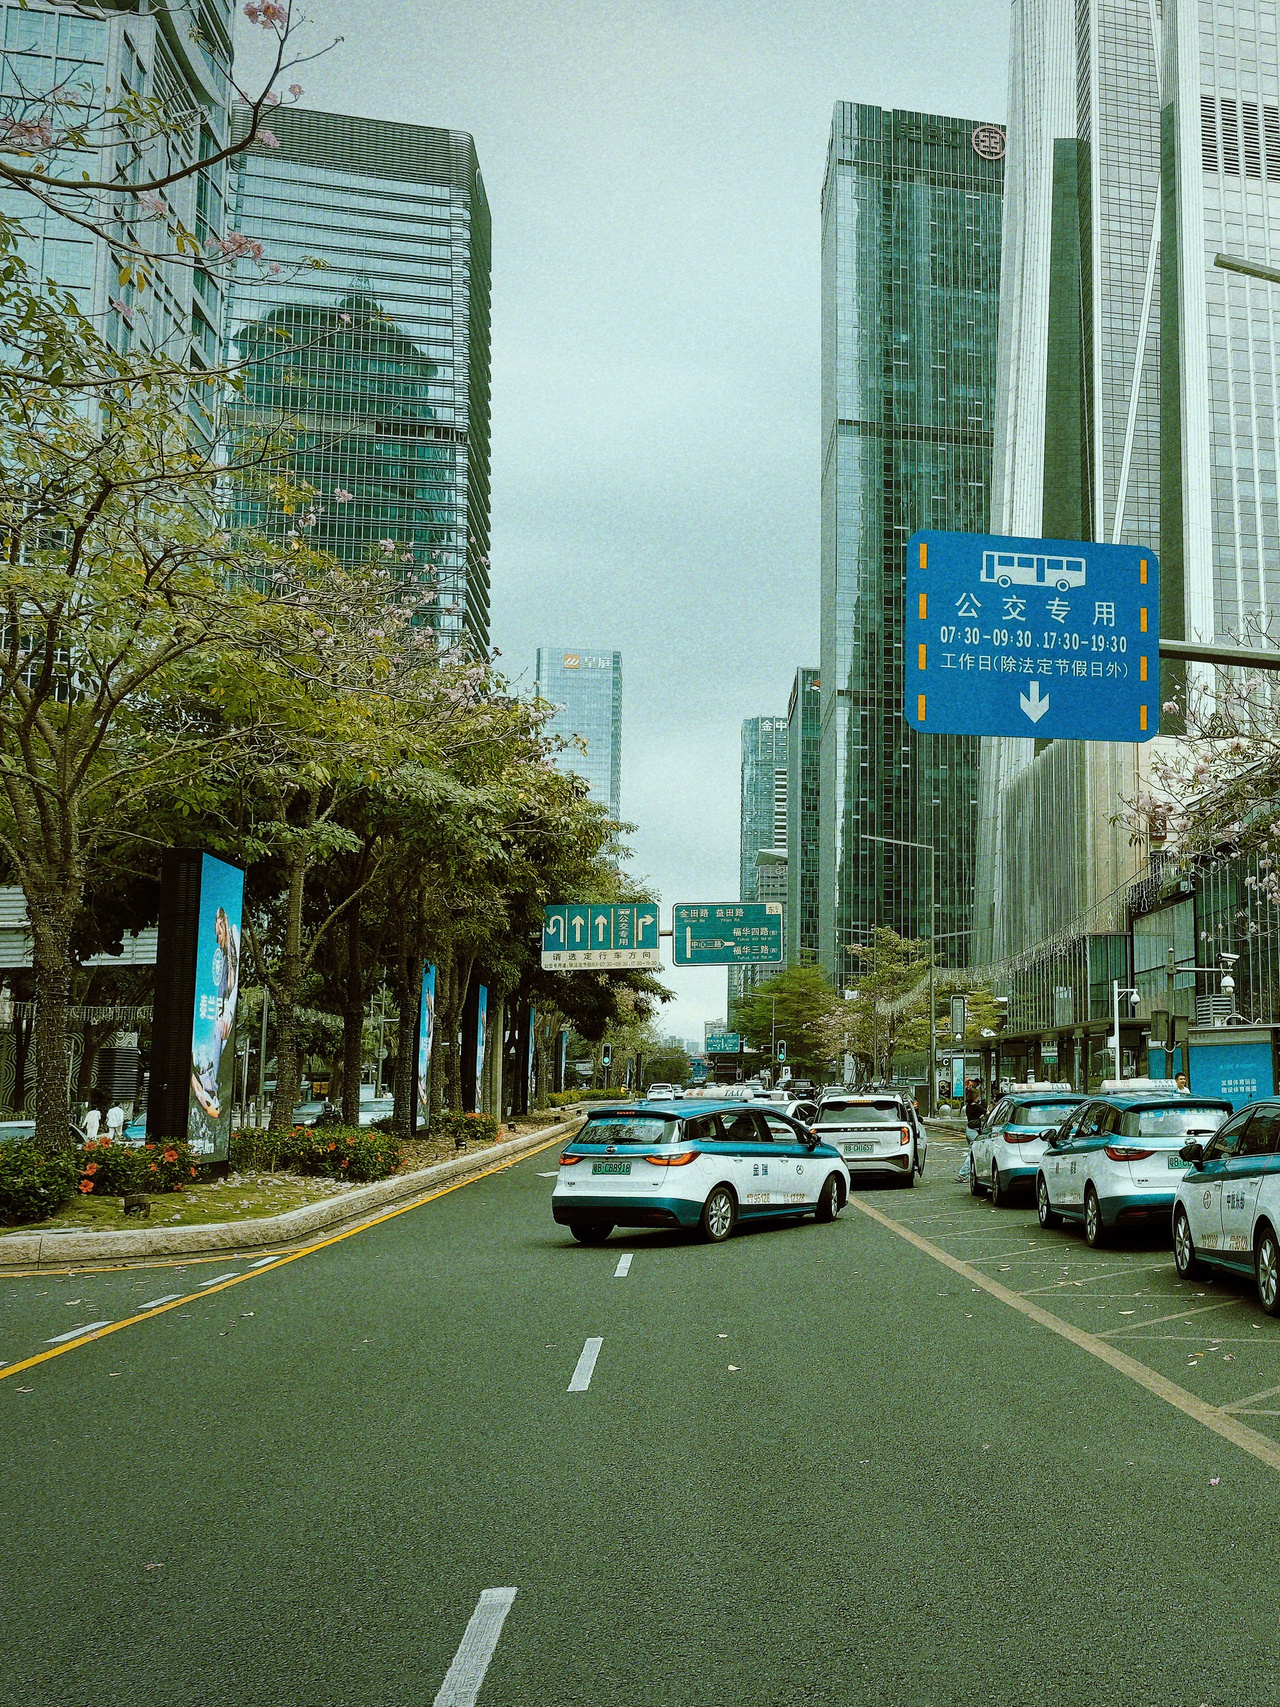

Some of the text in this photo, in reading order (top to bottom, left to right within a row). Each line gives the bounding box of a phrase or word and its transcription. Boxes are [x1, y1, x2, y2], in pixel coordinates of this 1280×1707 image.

[955, 592, 1116, 627] 公交专用
[583, 657, 613, 669] 皇庭
[618, 915, 629, 946] 公交专用
[552, 951, 651, 961] 请选定行车方向
[724, 1089, 745, 1097] TAXI
